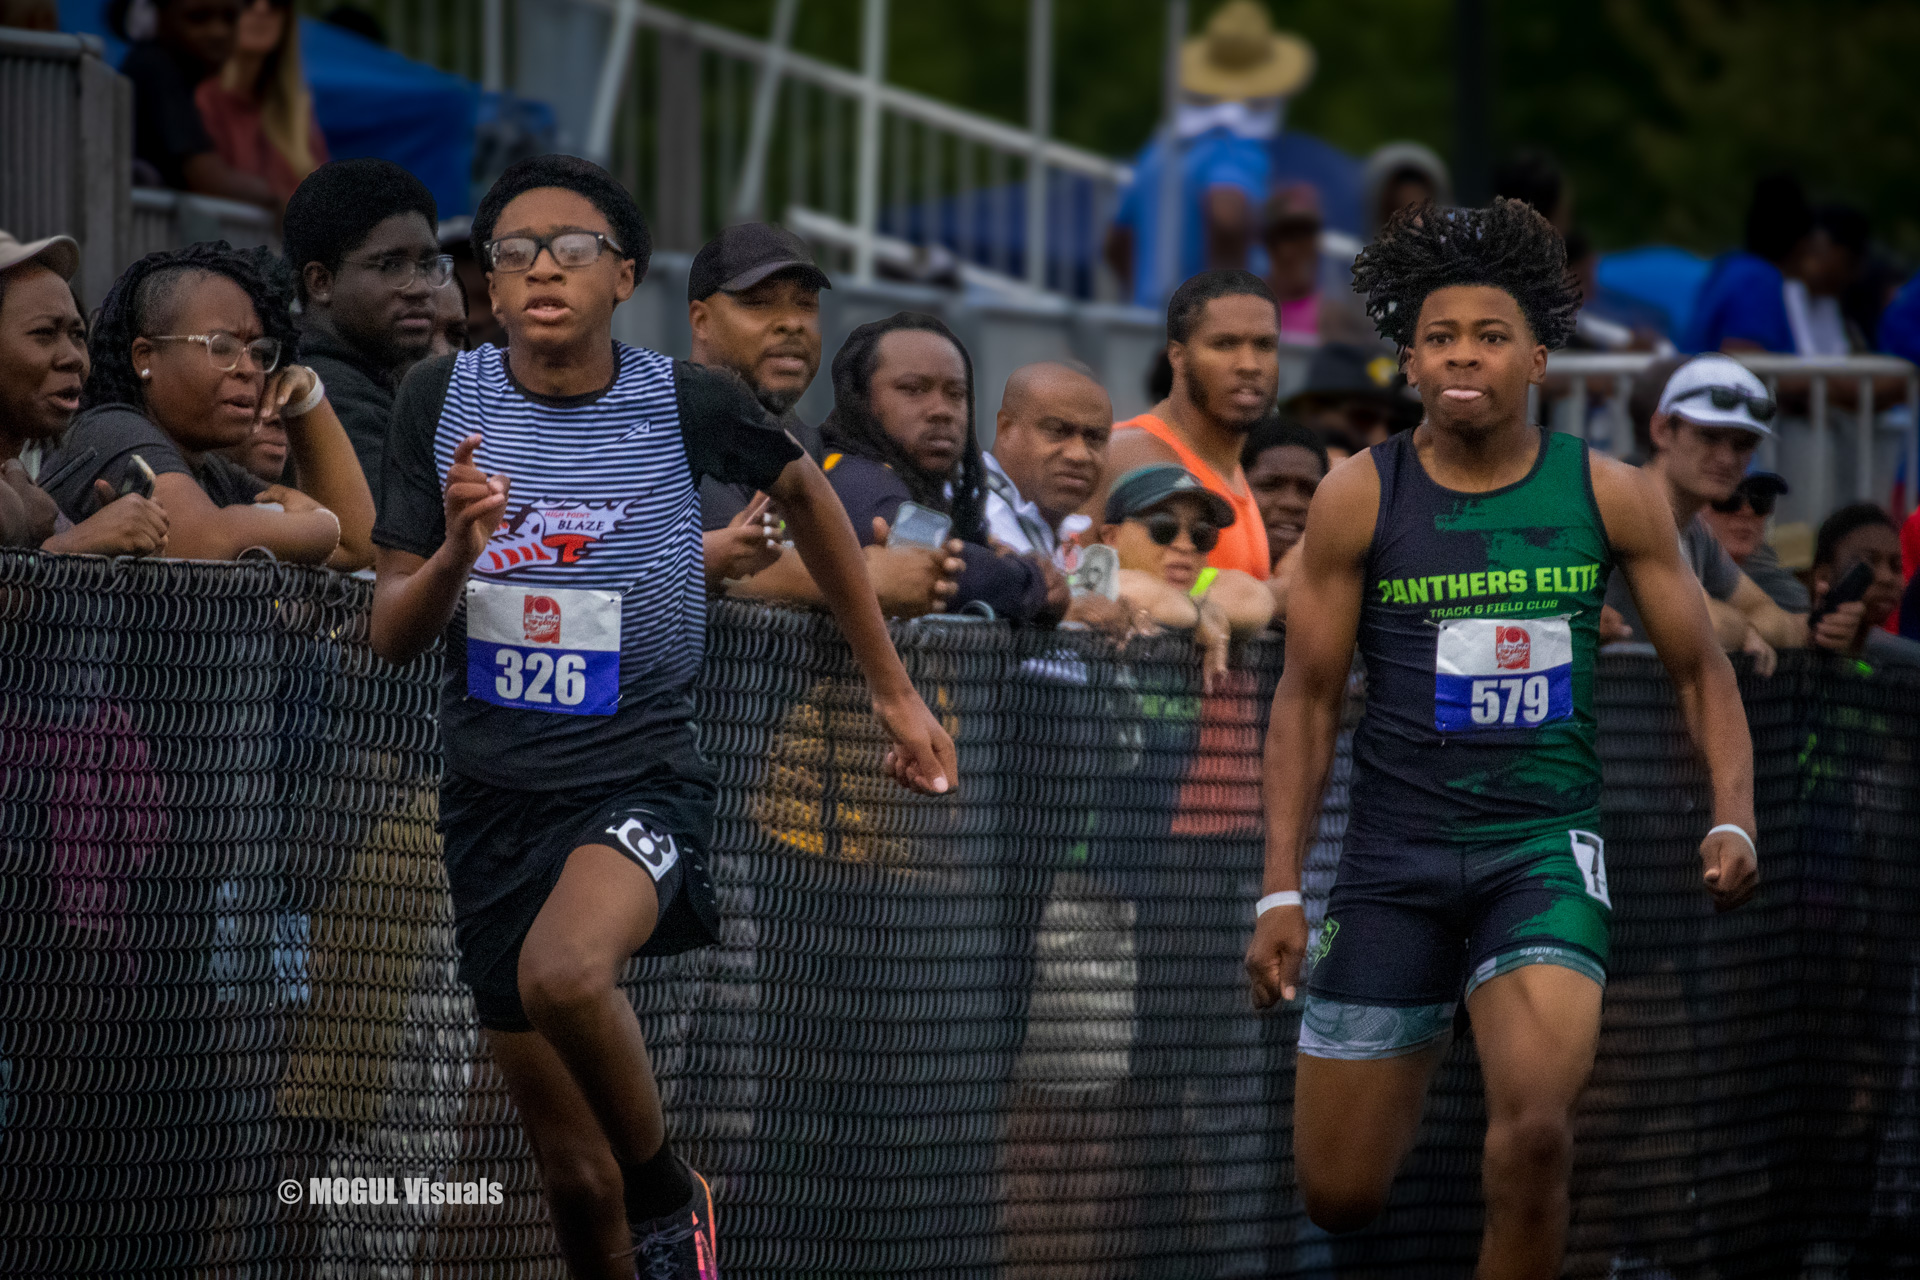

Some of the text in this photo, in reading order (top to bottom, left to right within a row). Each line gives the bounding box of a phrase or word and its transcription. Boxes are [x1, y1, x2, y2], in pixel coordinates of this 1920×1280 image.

[558, 520, 605, 531] BLAZE
[1378, 563, 1600, 604] PANTHERS ELITE
[1429, 605, 1472, 618] TRACK
[1486, 601, 1524, 614] FIELD
[1526, 599, 1559, 610] CLUB
[495, 648, 586, 706] 326
[1470, 675, 1549, 725] 579
[1576, 833, 1602, 895] 7
